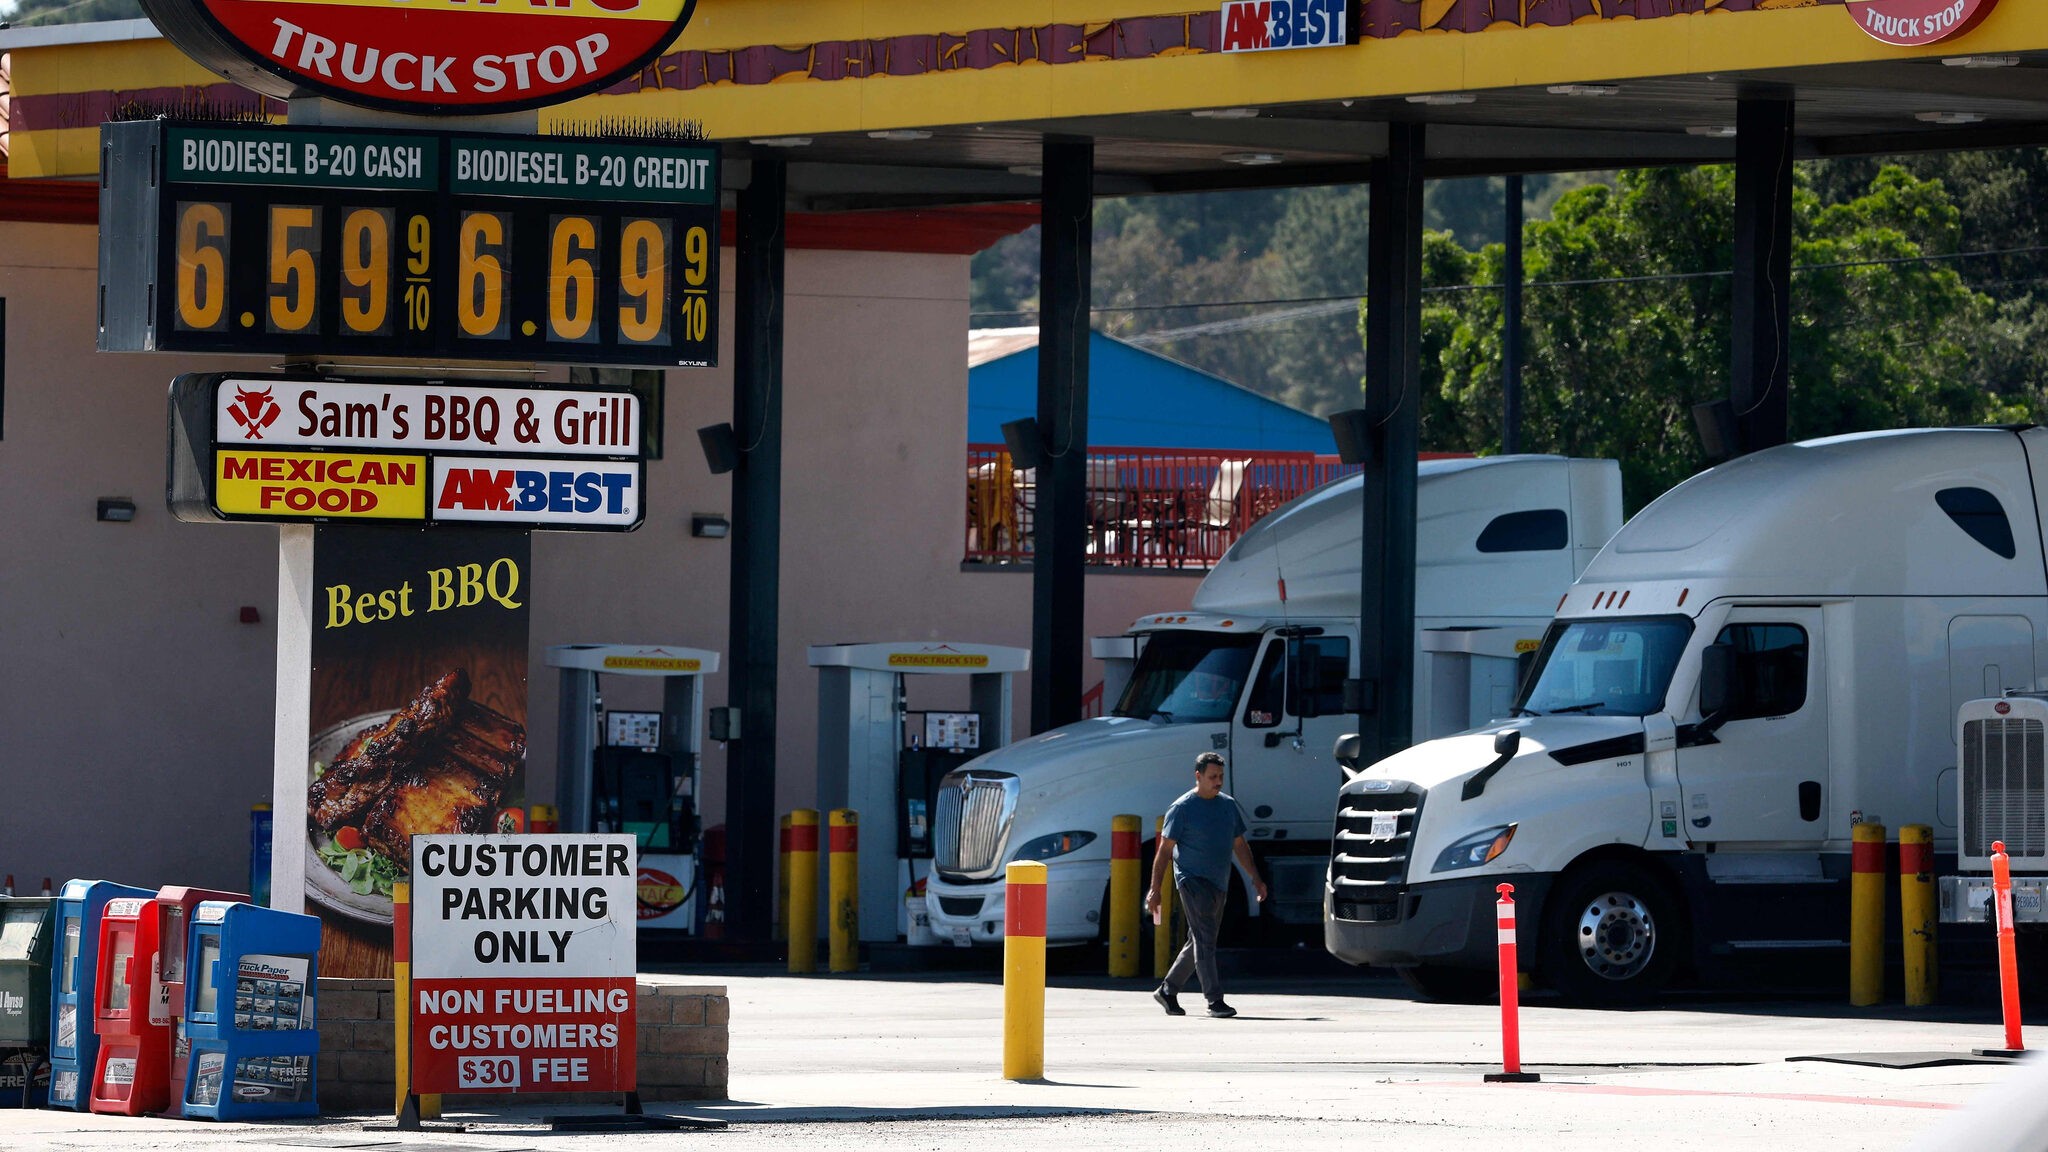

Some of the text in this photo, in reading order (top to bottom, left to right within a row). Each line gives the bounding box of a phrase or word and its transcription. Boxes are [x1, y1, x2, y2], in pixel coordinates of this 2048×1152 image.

[1865, 0, 1965, 38] TRUCK STOP
[271, 17, 611, 95] TRUCK STOP
[182, 139, 422, 179] BIODIESEL B-20 CASH
[457, 149, 710, 190] BIODIESEL B-20 CREDIT
[298, 389, 631, 446] Sam's BBQ & Grill
[223, 457, 416, 486] MEXICAN
[260, 486, 379, 513] FOOD
[325, 557, 522, 629] Best BBQ
[604, 657, 698, 669] CASTAIC TRUCK STOP
[889, 655, 987, 665] CASTAIC TRUCK STOP
[421, 843, 630, 877] CUSTOMER
[442, 886, 608, 920] PARKING
[639, 888, 675, 901] TAIC
[473, 930, 573, 963] ONLY
[419, 988, 629, 1014] NON FUELING
[429, 1023, 619, 1050] CUSTOMERS
[0, 1076, 25, 1087] FRE
[280, 1067, 308, 1076] FREE
[462, 1058, 589, 1084] $30 FEE
